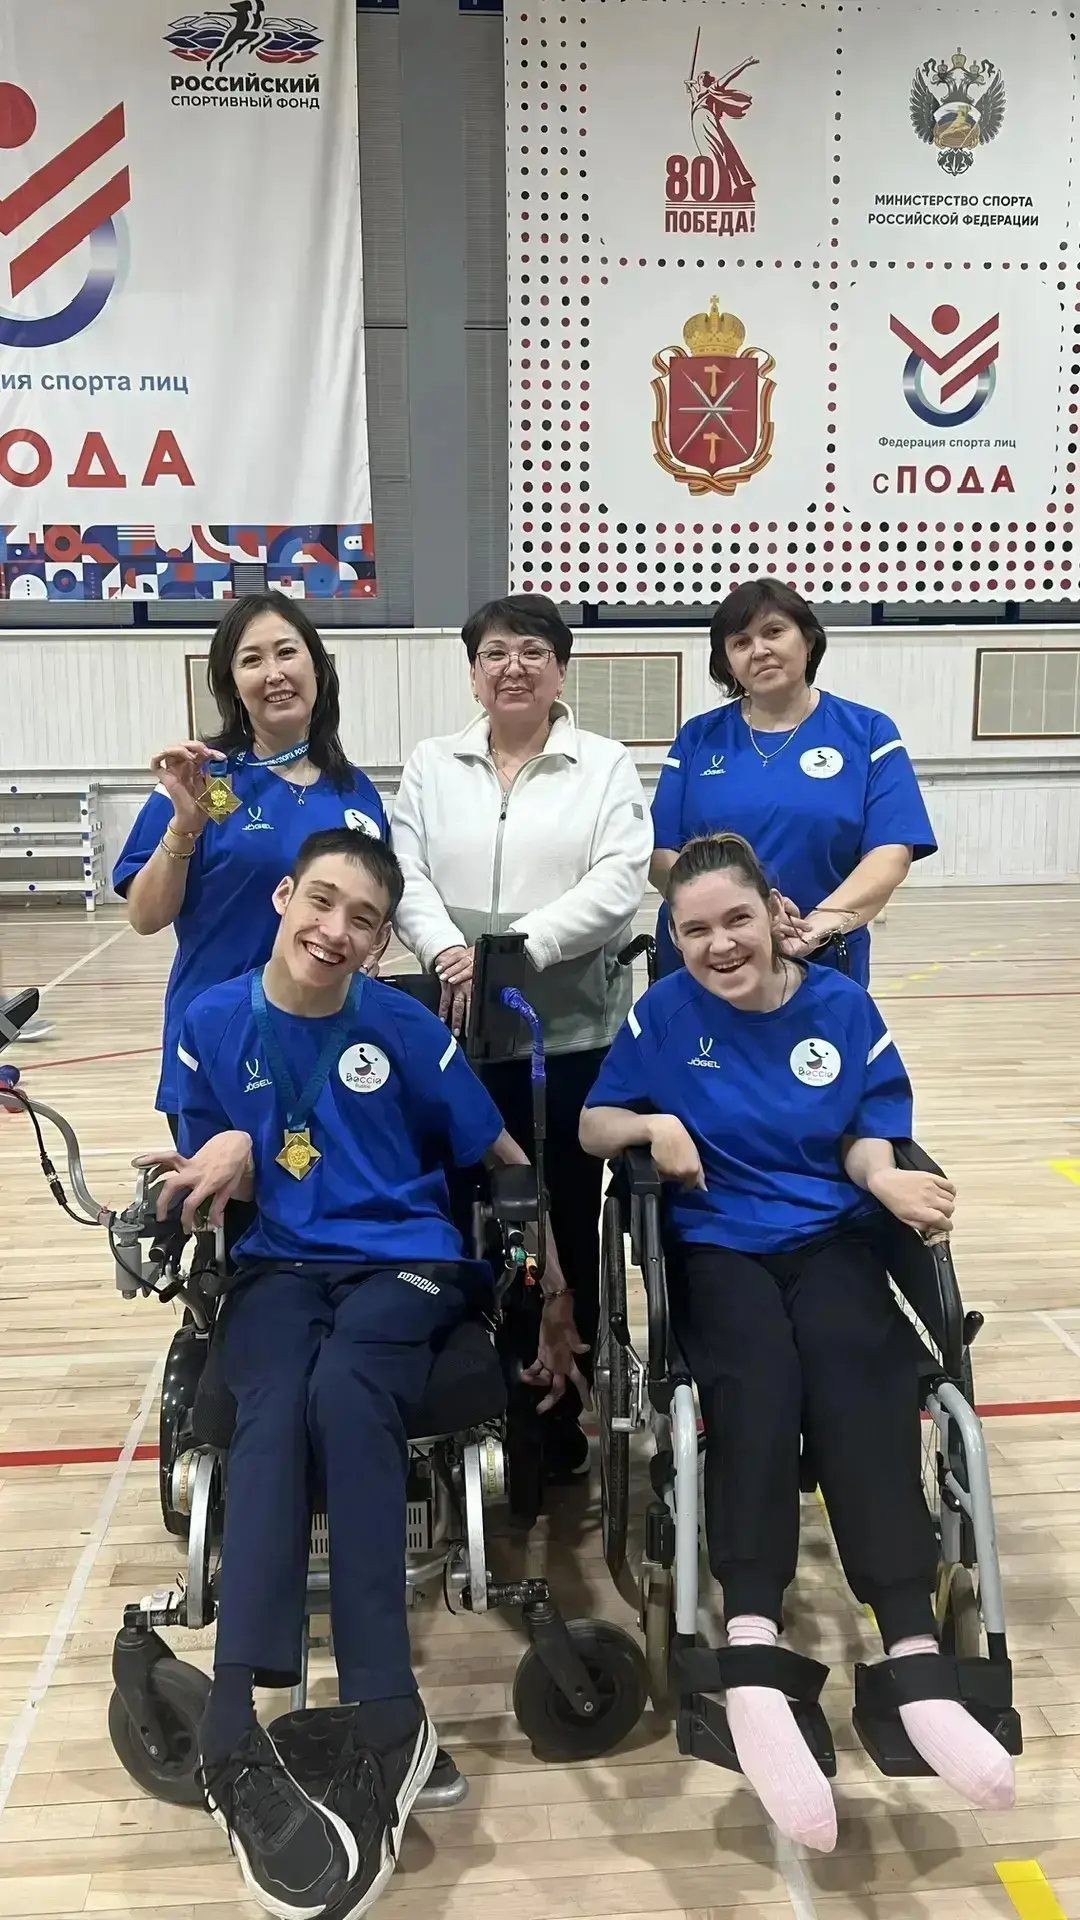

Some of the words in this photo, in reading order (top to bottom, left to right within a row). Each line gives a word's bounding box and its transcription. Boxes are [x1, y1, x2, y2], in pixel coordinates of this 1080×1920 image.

[170, 72, 320, 93] РОССИЙСКИЙ
[171, 95, 272, 108] СПОРТИВНЫЙ
[276, 97, 320, 109] ФОНД
[665, 154, 714, 201] 80
[874, 194, 979, 206] МИНИСТЕРСТВО
[982, 196, 1034, 207] СПОРТА
[665, 210, 756, 237] ПОБЕДА!
[868, 212, 959, 225] РОССИЙСКОЙ
[962, 214, 1039, 227] ФЕДЕРАЦИИ
[0, 373, 32, 390] ия
[41, 374, 132, 396] спорта
[139, 375, 189, 395] лиц
[878, 436, 946, 450] Федерация
[949, 438, 991, 449] спорта
[994, 438, 1017, 449] лиц
[0, 428, 196, 488] ОДА
[687, 1057, 721, 1069] JÖGEL
[345, 1072, 382, 1085] Boccia
[798, 1066, 834, 1079] Boccia
[243, 1078, 273, 1093] JÖGEL
